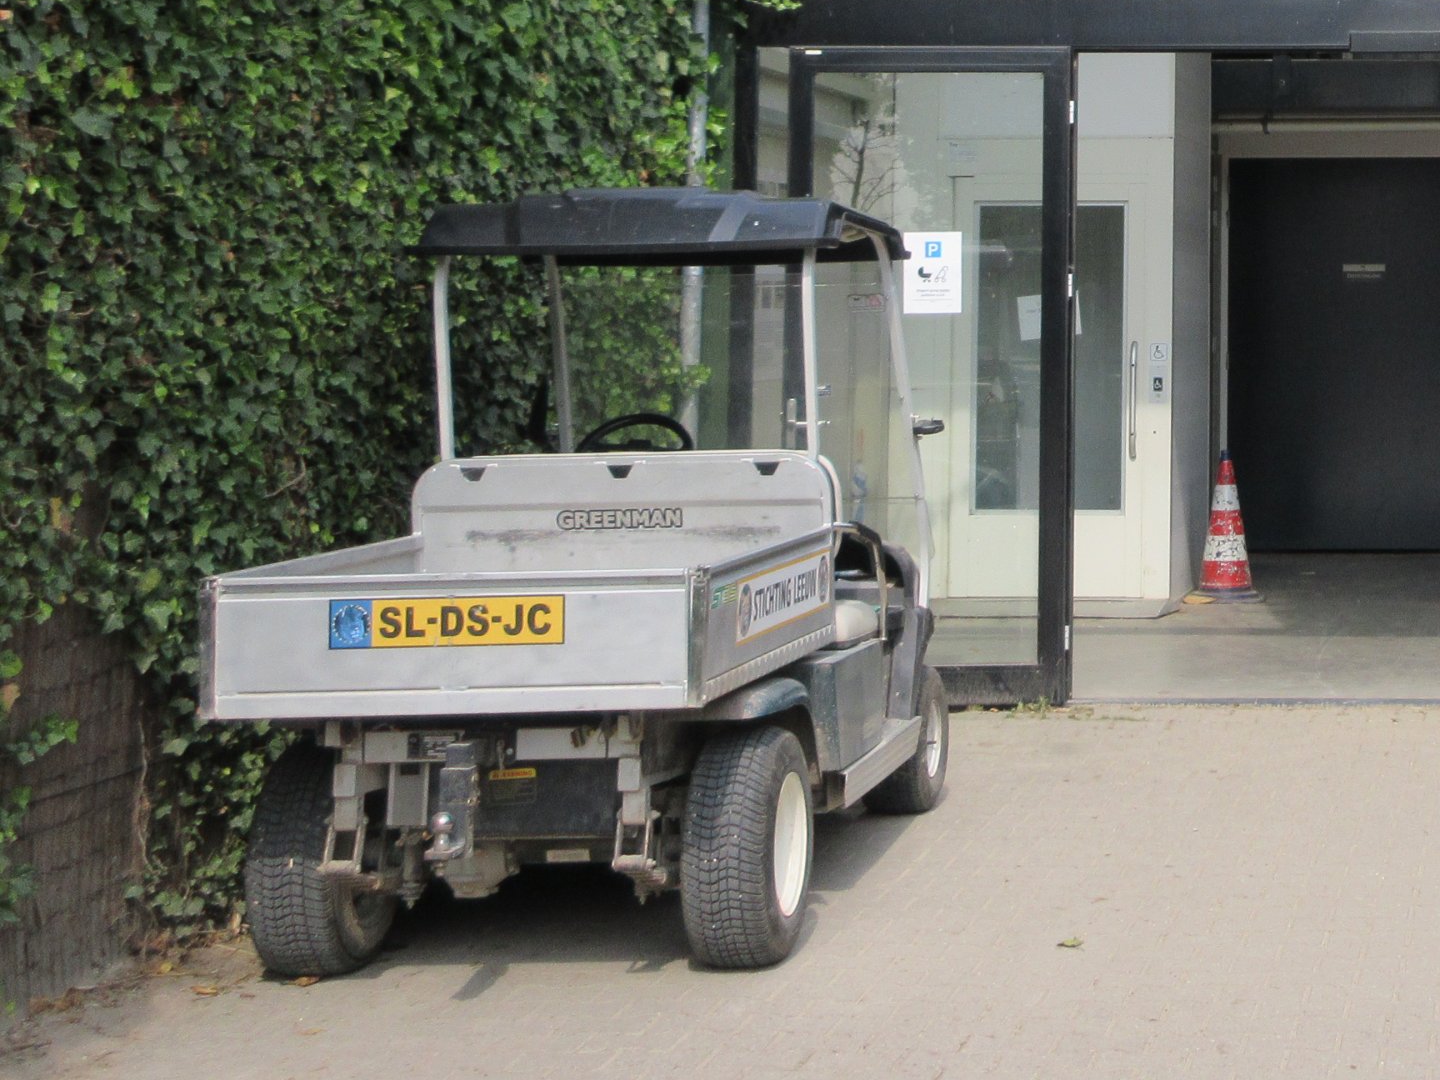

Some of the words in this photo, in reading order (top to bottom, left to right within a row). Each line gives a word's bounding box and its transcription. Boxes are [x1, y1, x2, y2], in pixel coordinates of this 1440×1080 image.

[928, 243, 938, 257] P
[557, 508, 683, 531] GREENMAN
[753, 578, 792, 621] STICHTING
[379, 603, 552, 639] SL-DS-JC
